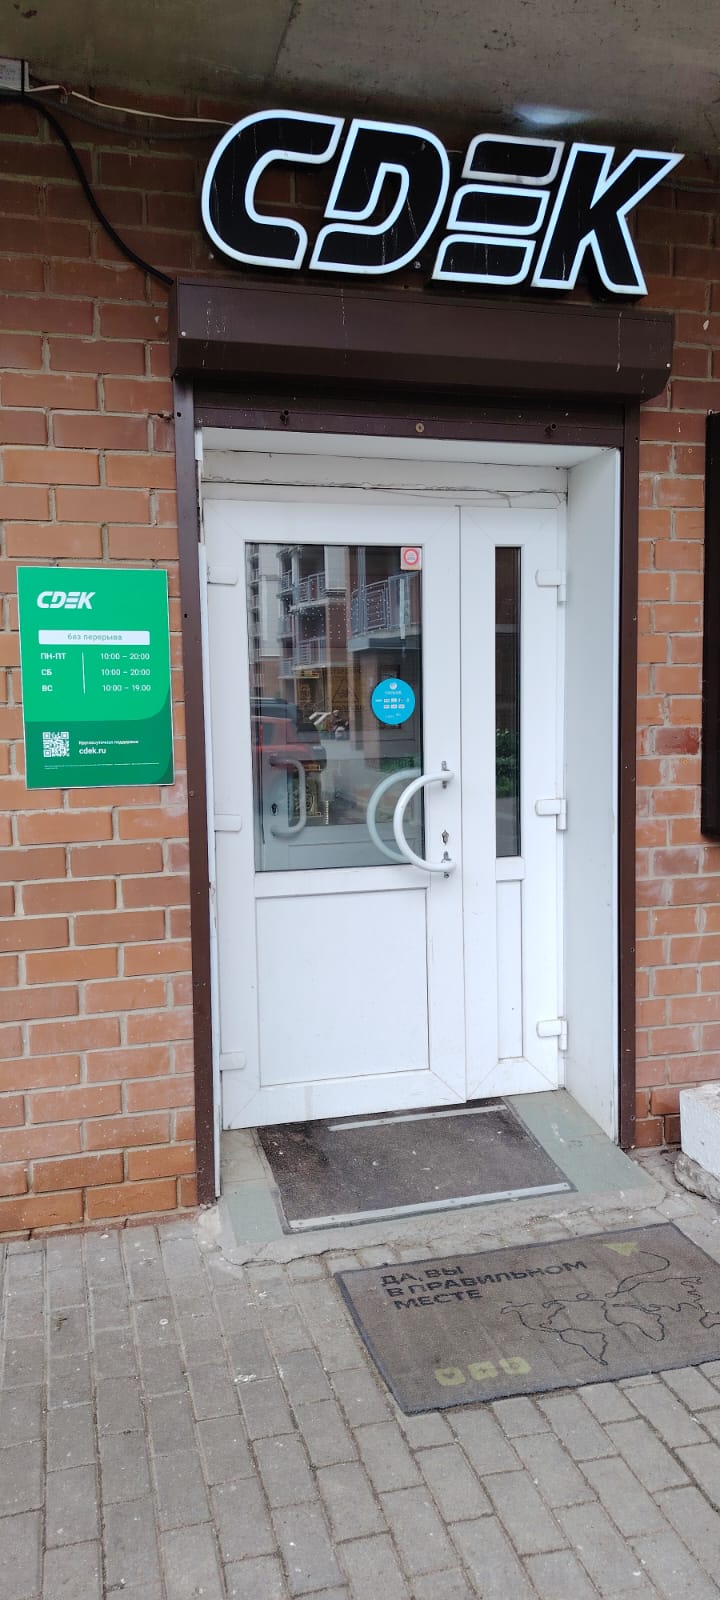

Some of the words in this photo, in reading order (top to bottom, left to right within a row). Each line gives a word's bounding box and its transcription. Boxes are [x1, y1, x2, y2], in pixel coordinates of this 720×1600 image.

[201, 109, 685, 296] CDEK
[37, 590, 96, 610] CDEK
[67, 632, 81, 641] без
[83, 633, 123, 643] перерыва
[40, 652, 67, 660] ПН-ПТ
[100, 652, 120, 660] 10:00
[129, 652, 151, 661] 20:00
[41, 668, 53, 676] СБ
[101, 668, 121, 676] 10:00
[130, 668, 151, 676] 20:00
[41, 684, 53, 692] ВС
[102, 684, 122, 692] 10:00
[78, 747, 107, 755] cdek.ru
[424, 1265, 465, 1279] ВЫ
[386, 1286, 405, 1298] В
[407, 1260, 588, 1295] ПРАВИЛЬНОМ
[392, 1289, 484, 1310] МЕСТЕ
